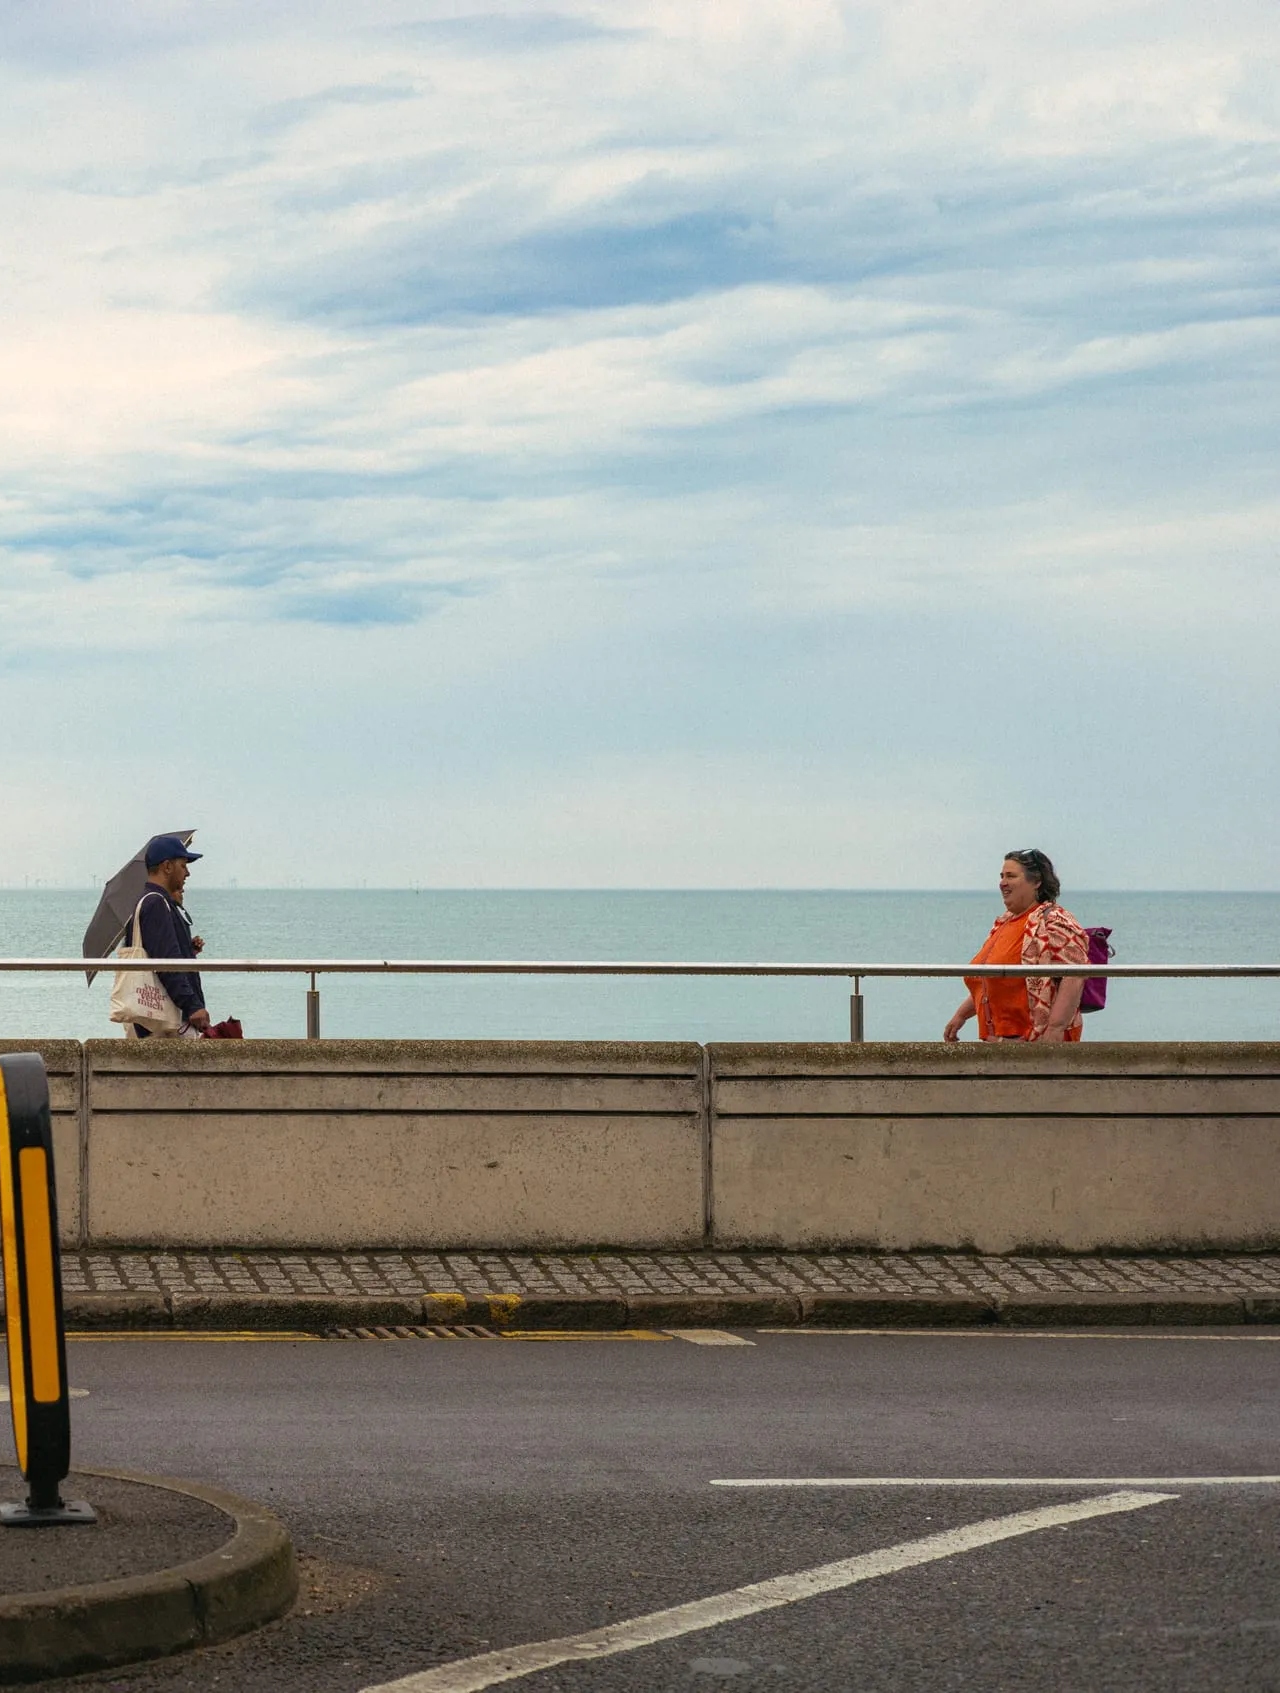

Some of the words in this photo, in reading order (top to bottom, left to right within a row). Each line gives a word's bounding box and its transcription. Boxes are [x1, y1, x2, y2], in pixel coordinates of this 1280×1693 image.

[136, 987, 165, 1000] matter
[144, 983, 160, 993] you
[138, 998, 163, 1011] much
[141, 993, 160, 1005] very
